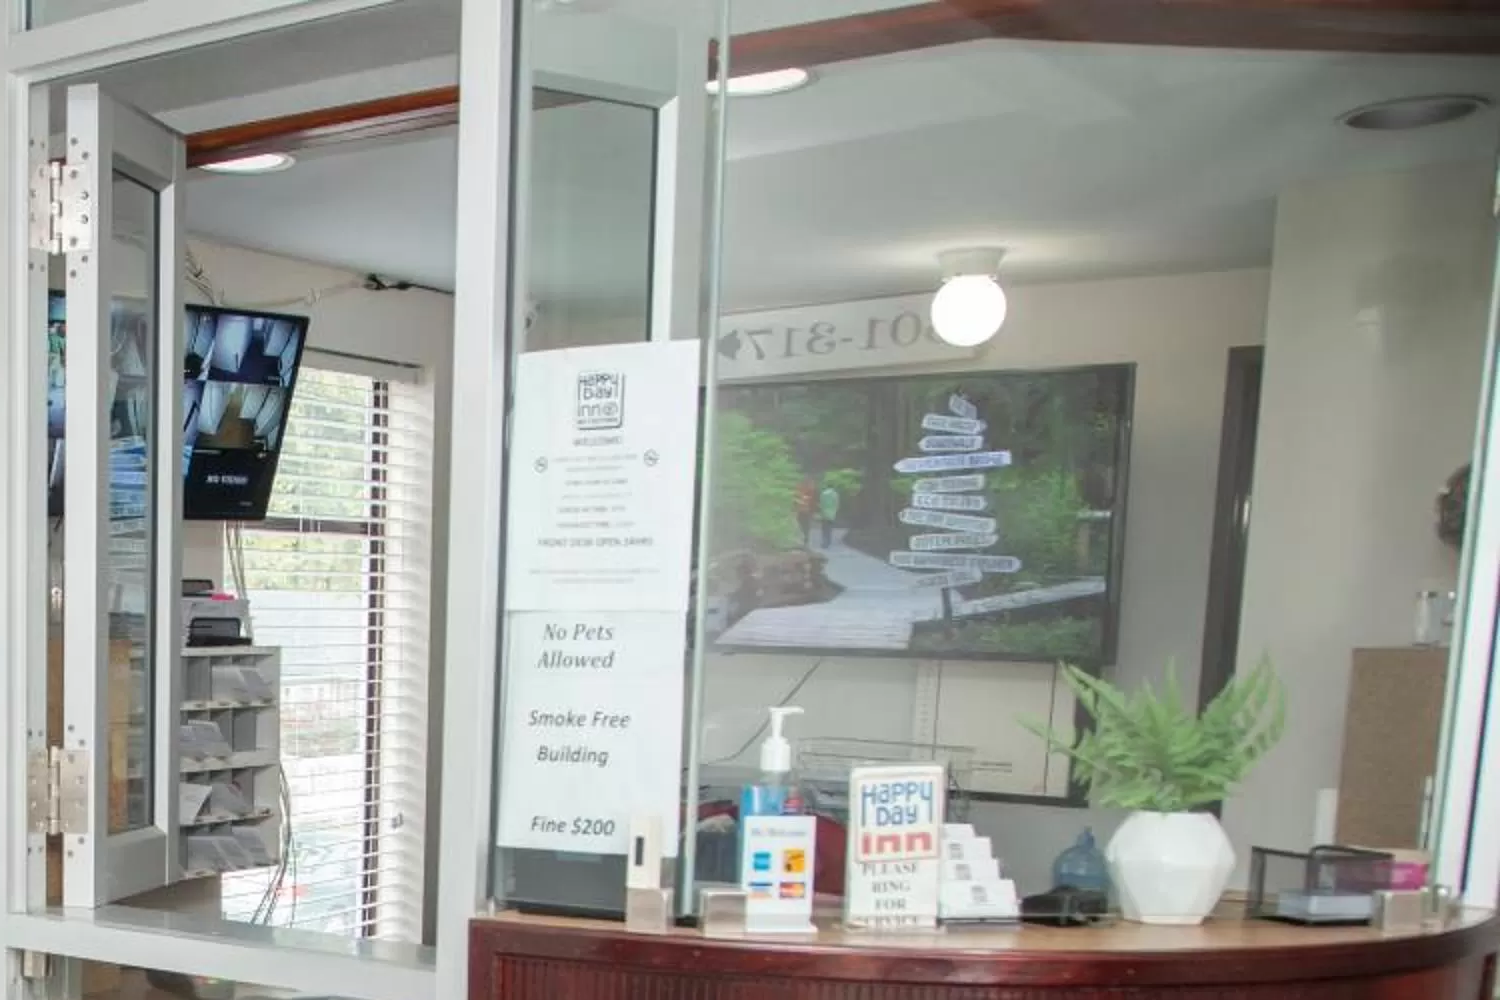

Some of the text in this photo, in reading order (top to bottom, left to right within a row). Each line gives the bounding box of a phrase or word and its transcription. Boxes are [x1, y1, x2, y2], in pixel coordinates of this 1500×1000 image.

[543, 623, 614, 641] No Pets
[537, 651, 615, 669] Allowed
[528, 709, 631, 729] Smoke Free
[537, 745, 609, 767] Building
[531, 816, 615, 836] Fine $200
[862, 862, 918, 876] PLEASE
[871, 880, 911, 893] RING
[875, 899, 907, 910] FOR
